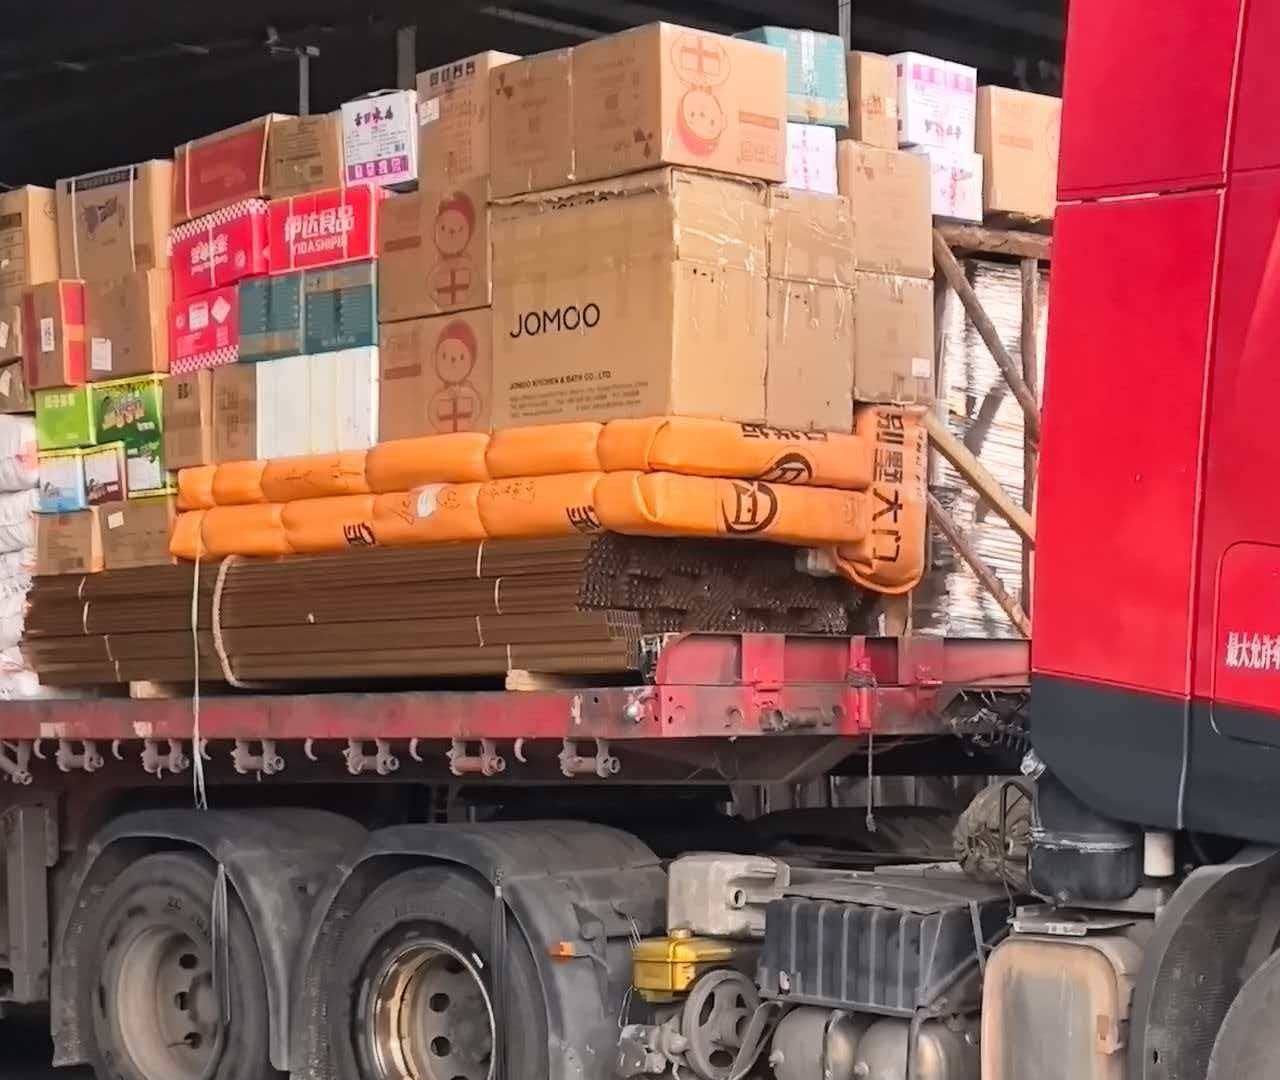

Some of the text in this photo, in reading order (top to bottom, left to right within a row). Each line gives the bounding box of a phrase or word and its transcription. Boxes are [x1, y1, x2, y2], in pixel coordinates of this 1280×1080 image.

[510, 303, 600, 338] JOMOO
[872, 410, 904, 563] 别墅大门
